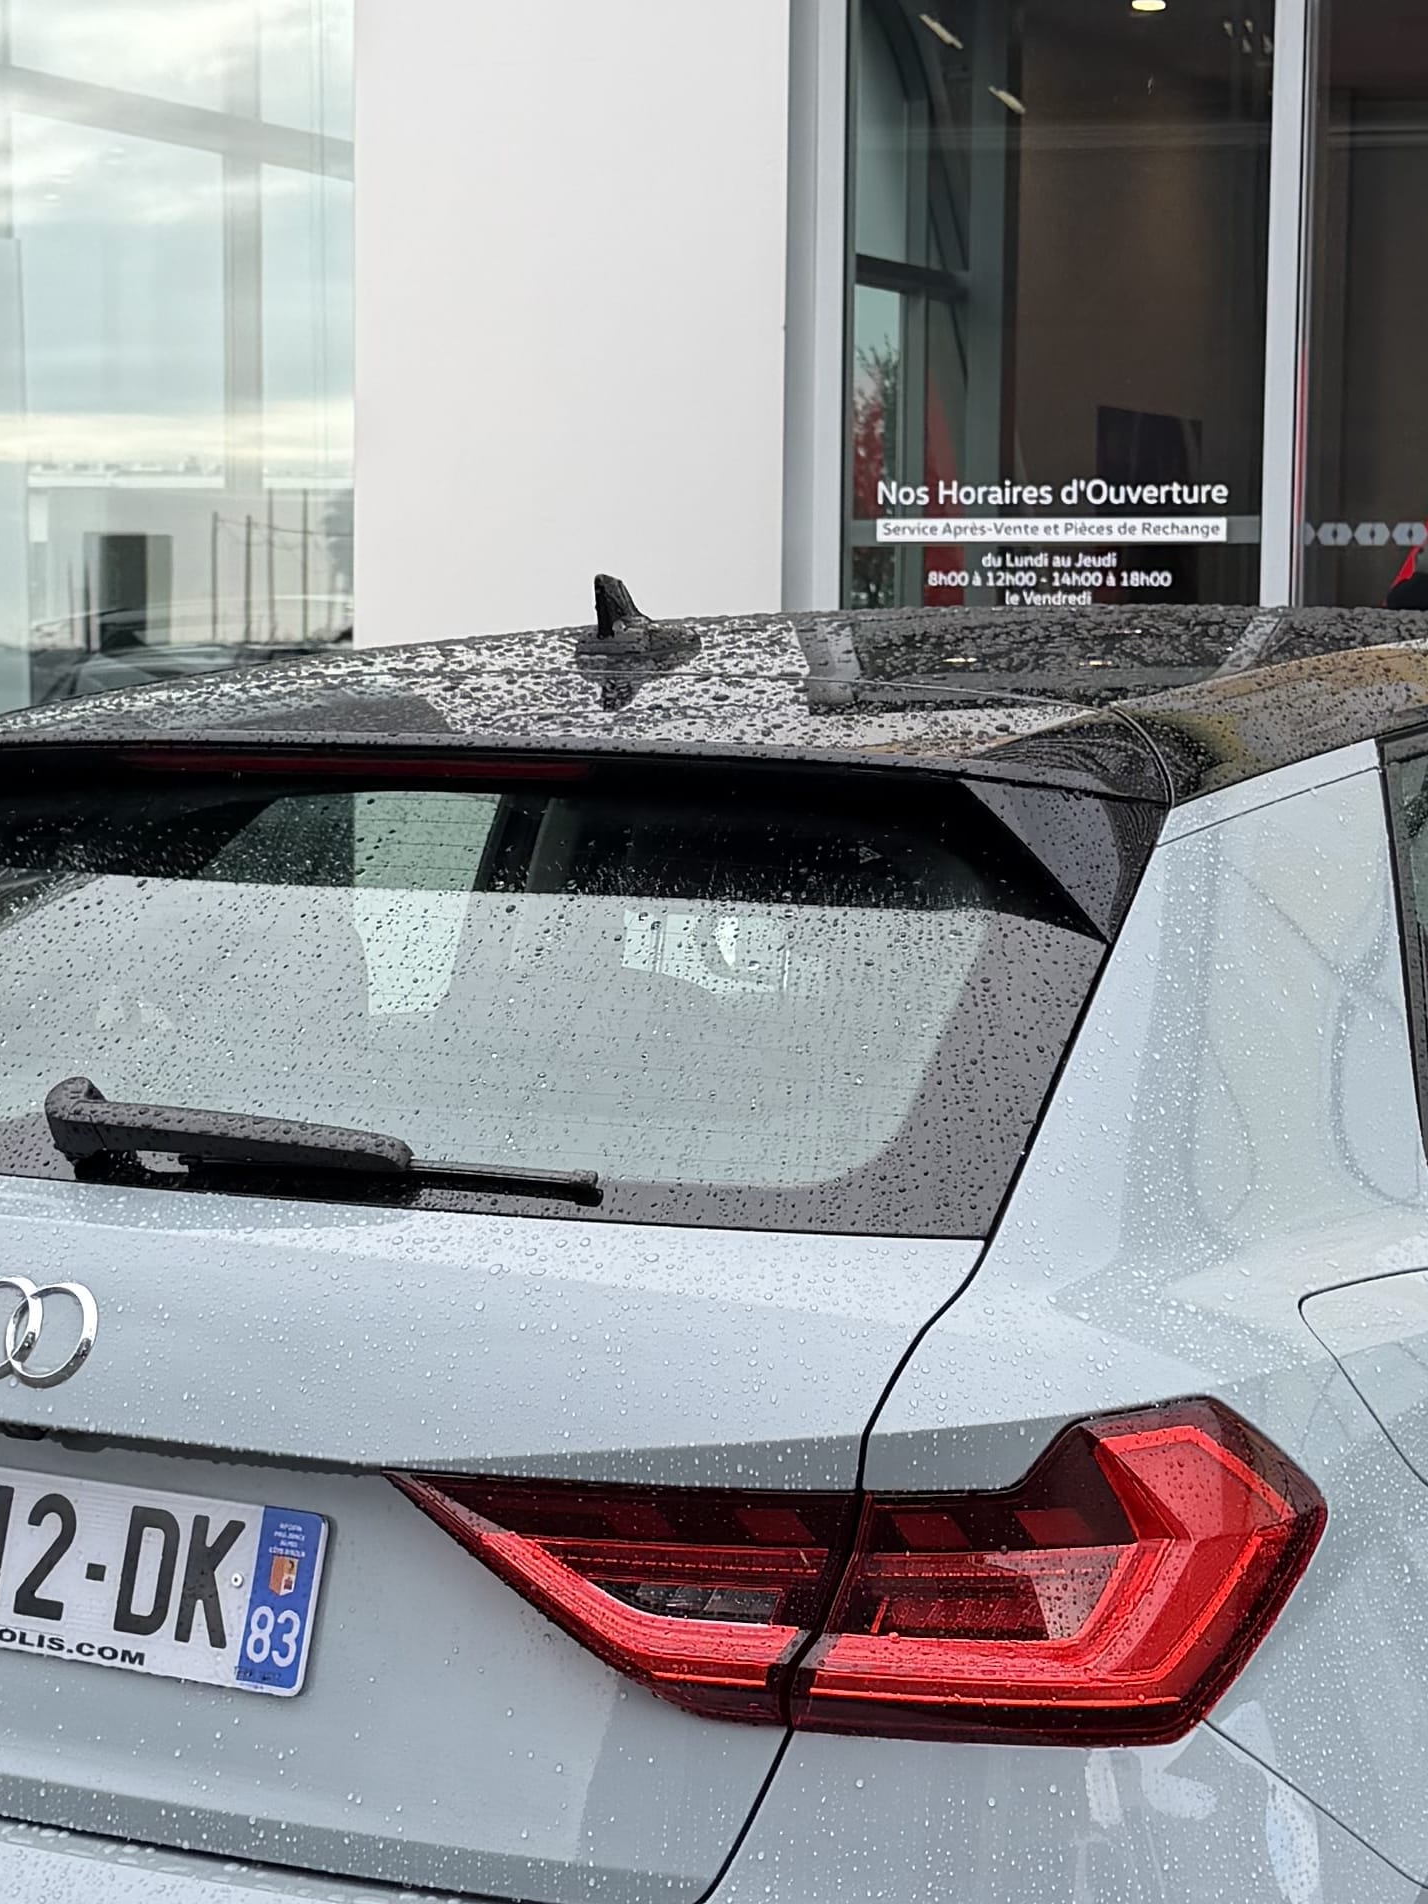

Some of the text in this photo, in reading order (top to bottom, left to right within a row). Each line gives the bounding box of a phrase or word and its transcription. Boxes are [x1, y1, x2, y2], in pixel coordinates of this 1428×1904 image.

[876, 478, 1229, 505] Nos Horaires d'Ouverture
[882, 522, 1221, 539] Service Après-Vente et Pièces de Rechange
[982, 552, 1118, 567] du Lundi au Jeudi
[927, 571, 970, 587] 8h00
[972, 571, 982, 587] à
[986, 571, 1037, 587] 12h00
[1051, 571, 1103, 587] 14h00
[1105, 571, 1116, 587] à
[1120, 571, 1173, 587] 18h00
[1005, 590, 1093, 606] le Vendredi
[245, 1606, 301, 1668] 83
